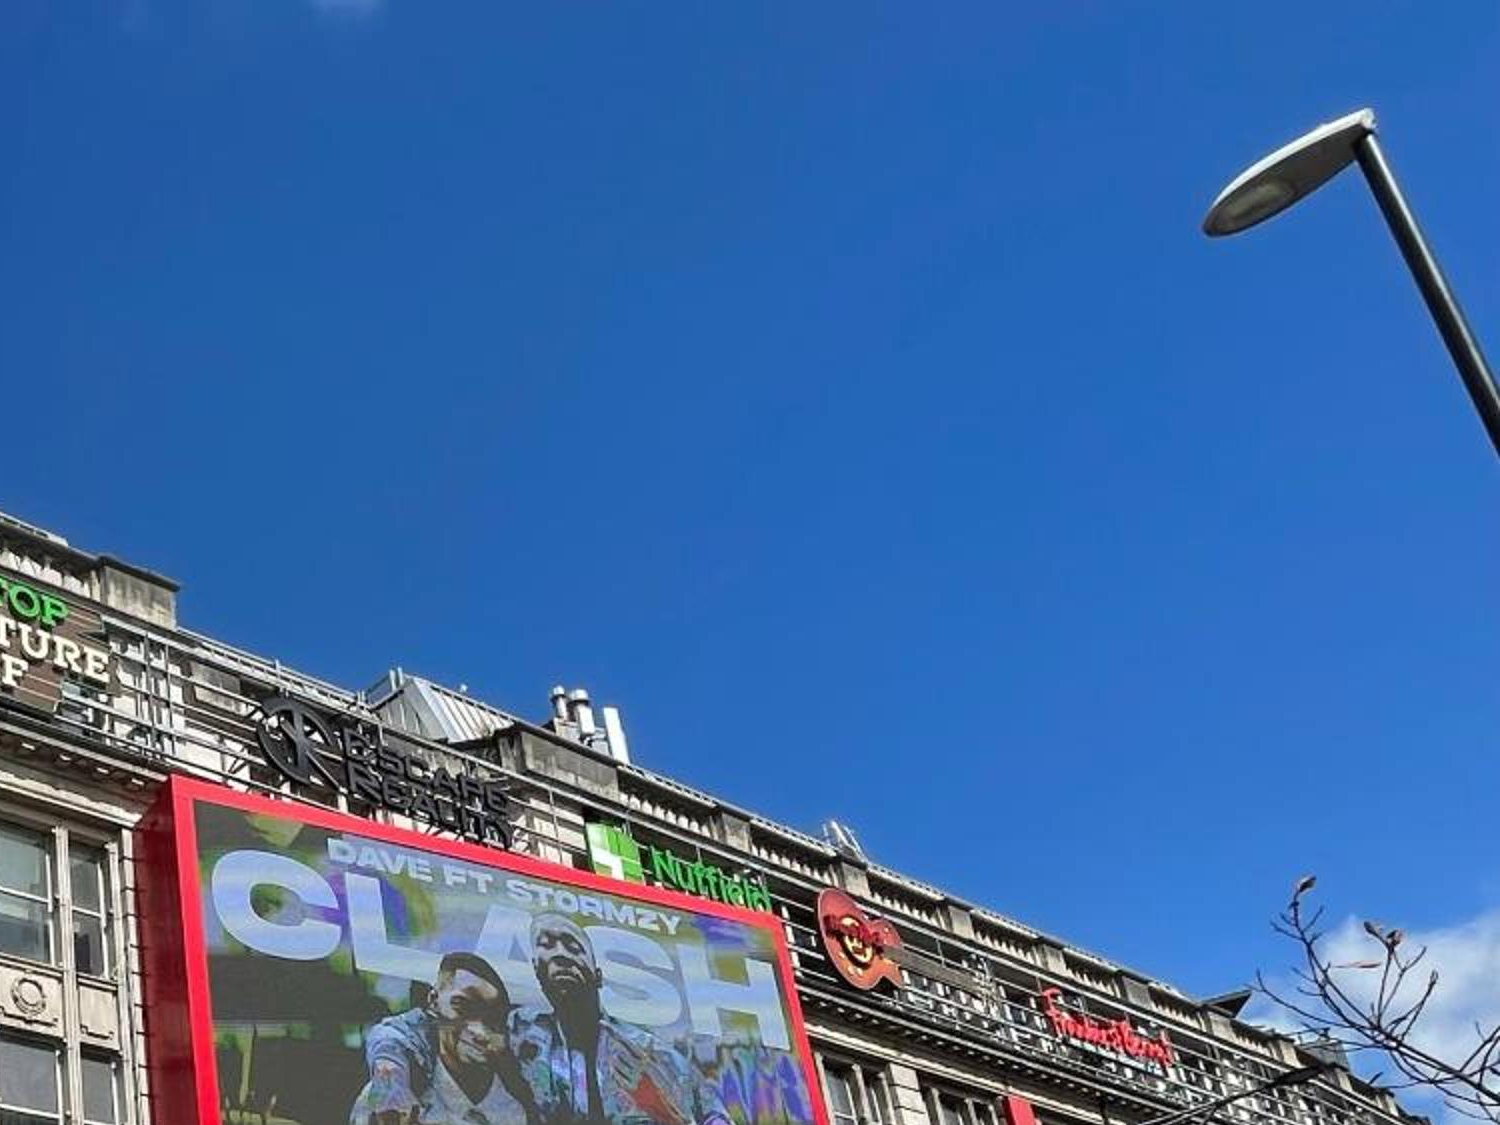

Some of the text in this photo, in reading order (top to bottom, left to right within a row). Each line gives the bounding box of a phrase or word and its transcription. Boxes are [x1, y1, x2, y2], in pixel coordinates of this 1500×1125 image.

[326, 837, 684, 936] DAVE FT STORMZY
[649, 845, 773, 913] Nuffield
[211, 848, 792, 1051] CLASH
